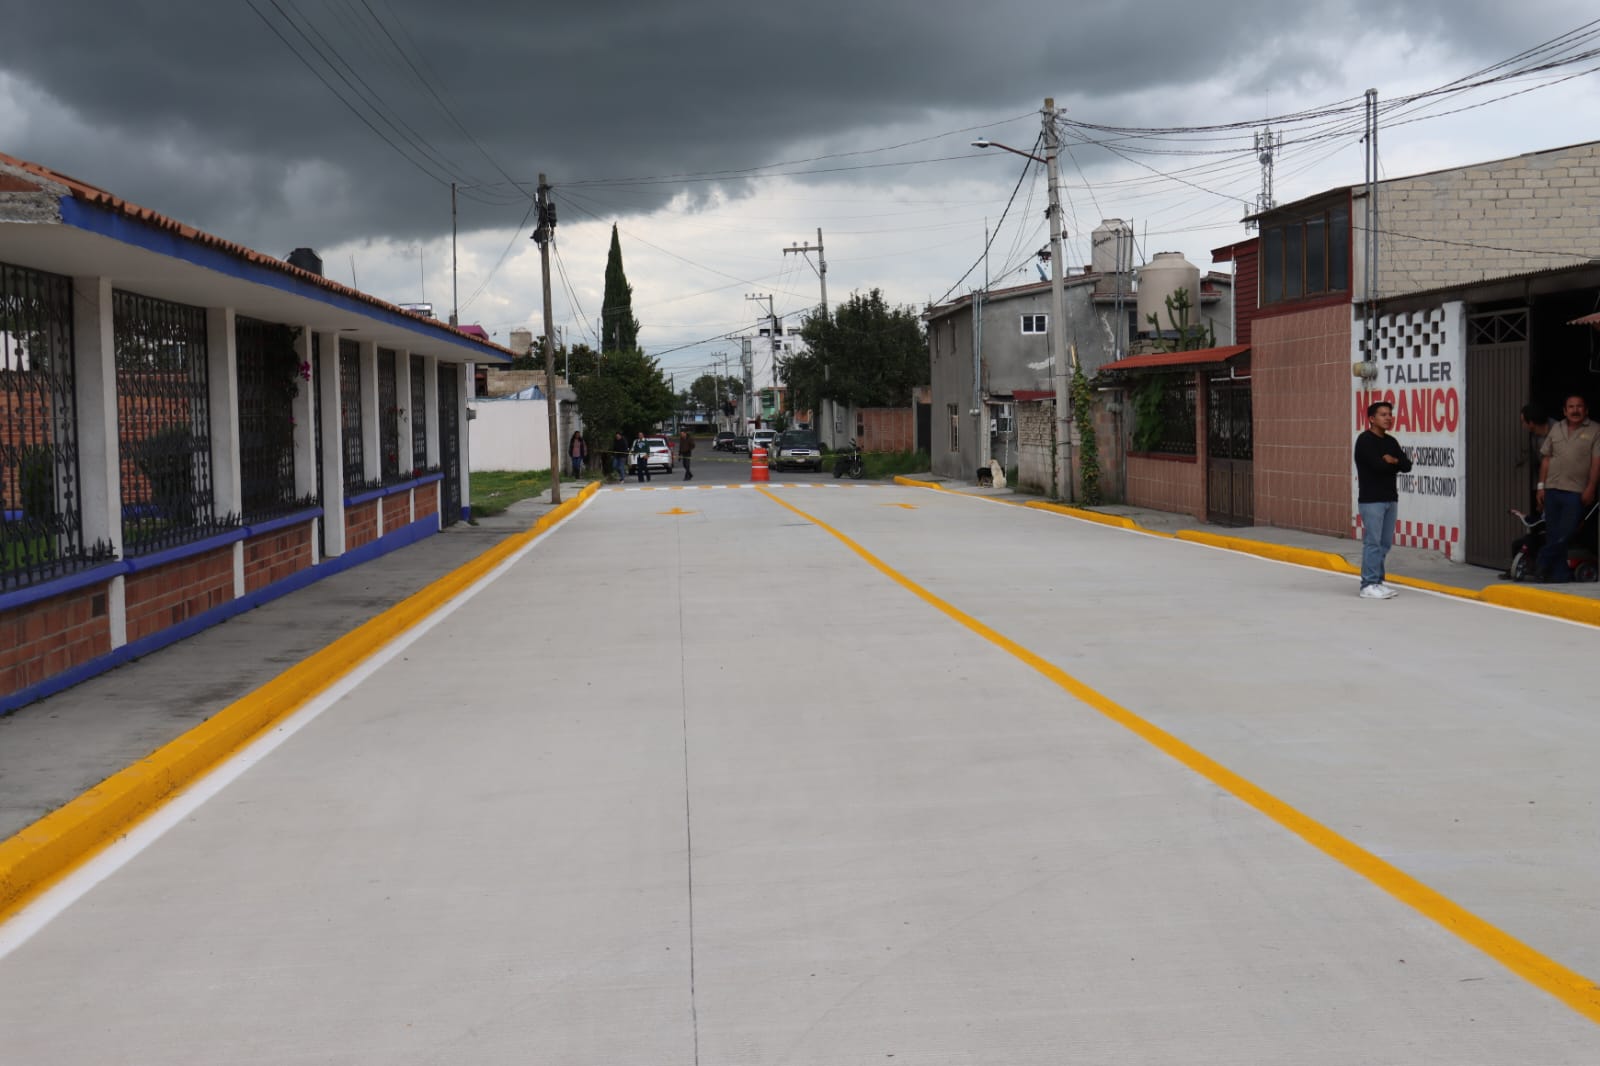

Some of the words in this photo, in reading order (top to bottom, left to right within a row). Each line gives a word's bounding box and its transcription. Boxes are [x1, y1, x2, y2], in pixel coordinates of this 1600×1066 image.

[1384, 361, 1452, 384] TALLER
[1416, 446, 1455, 468] SUSPENSIONES
[1397, 473, 1415, 494] TORES
